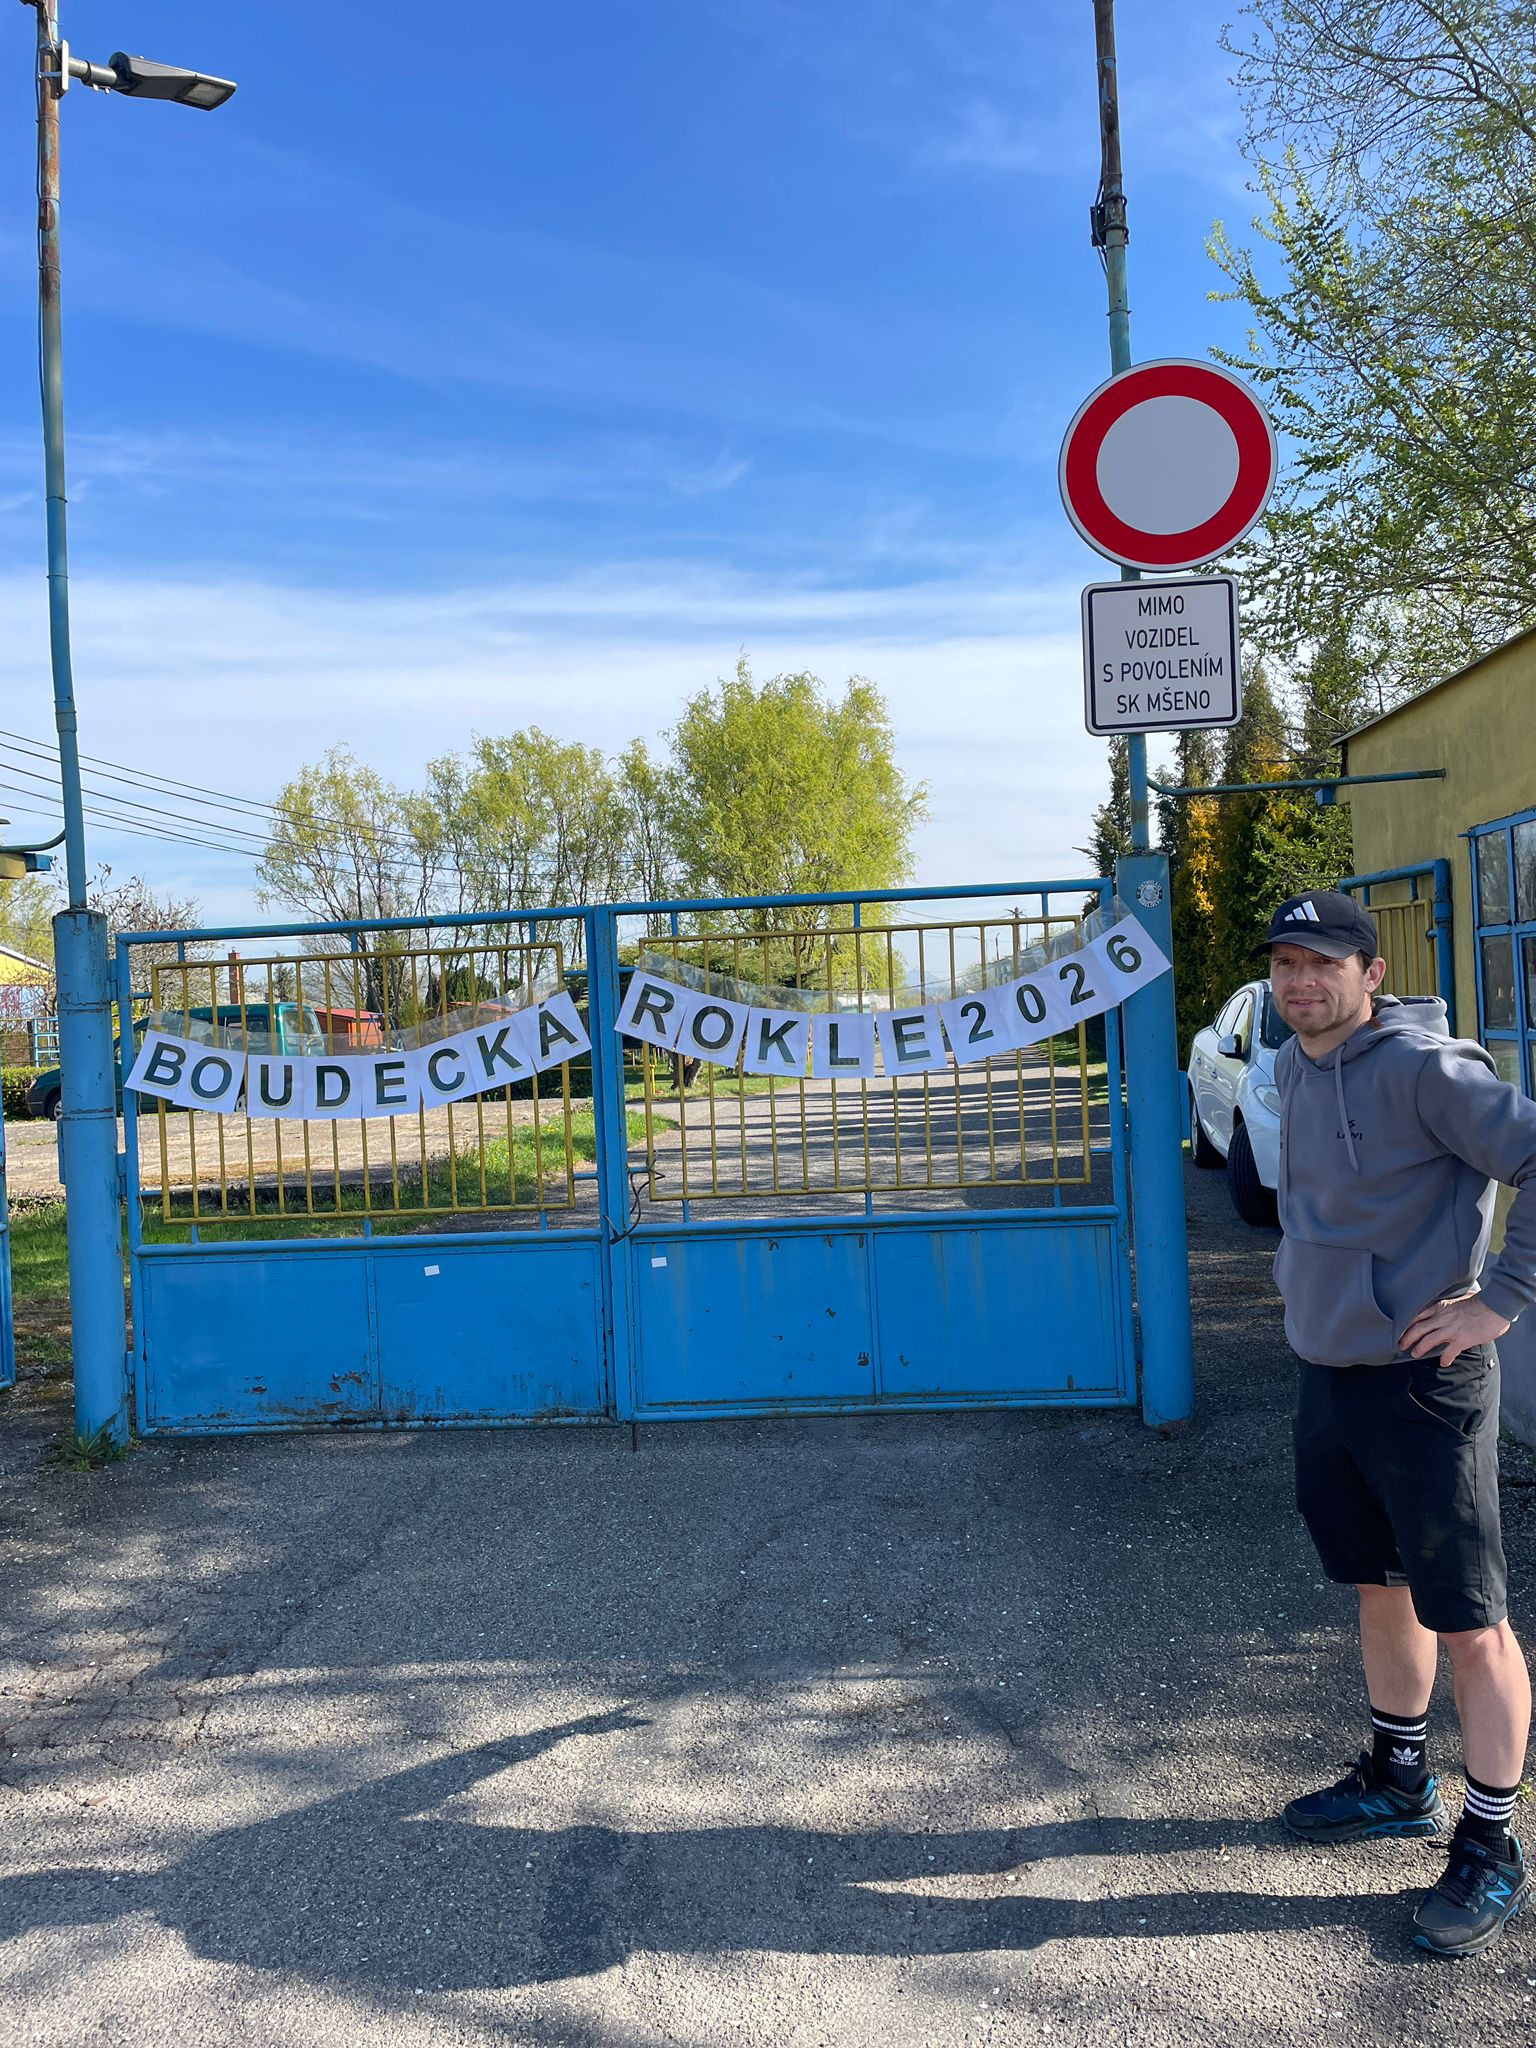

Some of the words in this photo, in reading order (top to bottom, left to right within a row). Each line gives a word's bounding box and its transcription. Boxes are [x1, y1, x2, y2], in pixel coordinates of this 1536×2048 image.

[1138, 595, 1185, 616] MIMO
[1125, 627, 1200, 649] VOZIDEL
[1103, 663, 1114, 683] S
[1121, 652, 1223, 682] POVOLENÍM
[1116, 693, 1141, 714] SK
[1147, 686, 1211, 712] MŠENO
[142, 1002, 579, 1109] BOUDECKÁ
[630, 982, 932, 1066] ROKLE
[960, 934, 1142, 1044] 2026
